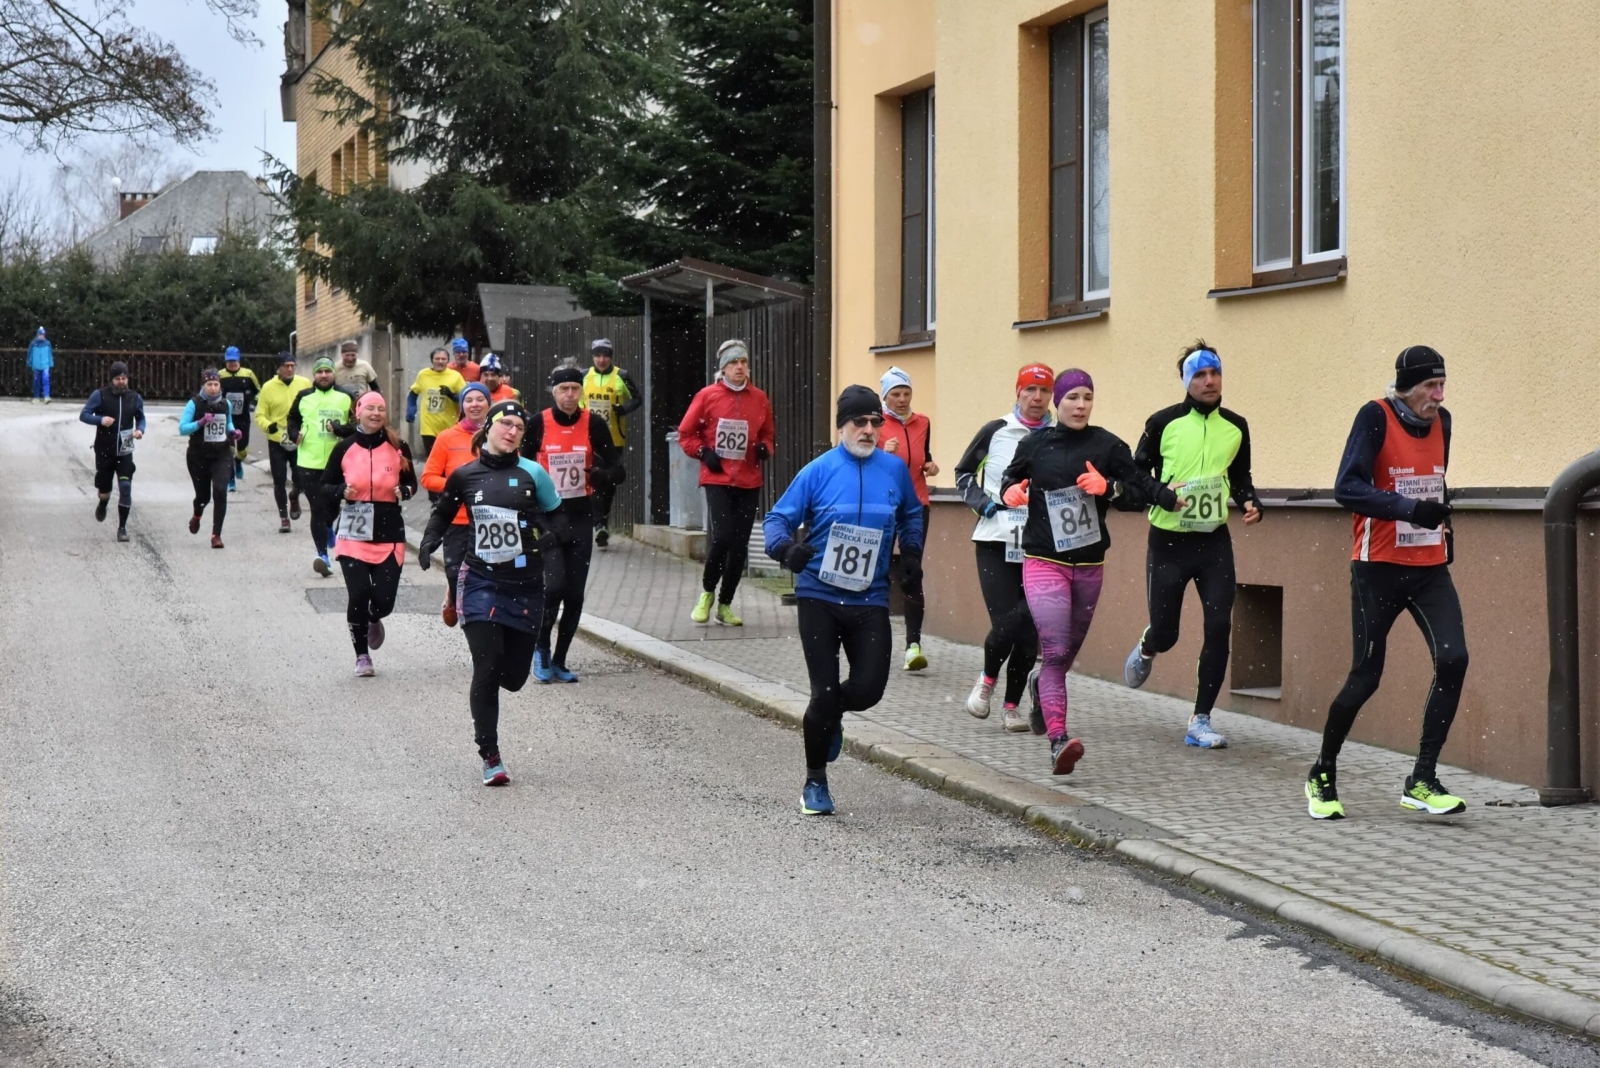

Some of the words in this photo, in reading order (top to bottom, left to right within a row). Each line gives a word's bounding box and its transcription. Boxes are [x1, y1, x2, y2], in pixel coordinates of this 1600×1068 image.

[427, 395, 445, 409] 167
[588, 392, 610, 400] KRB
[205, 422, 225, 436] 195
[716, 430, 747, 451] 262
[556, 465, 580, 488] 79
[1398, 477, 1420, 487] ZIMNÍ
[1047, 491, 1067, 500] ZIMNÍ
[1398, 484, 1429, 495] BĚŽECKÁ
[1048, 495, 1077, 507] BĚŽECKÁ
[1181, 491, 1223, 520] 261
[346, 514, 367, 535] 72
[1008, 514, 1026, 522] BĚŽEC
[1060, 502, 1092, 535] 84
[477, 521, 519, 550] 288
[832, 524, 855, 534] ZIMNÍ
[831, 530, 861, 543] BĚŽECKÁ
[863, 537, 879, 546] LIGA
[832, 543, 873, 578] 181
